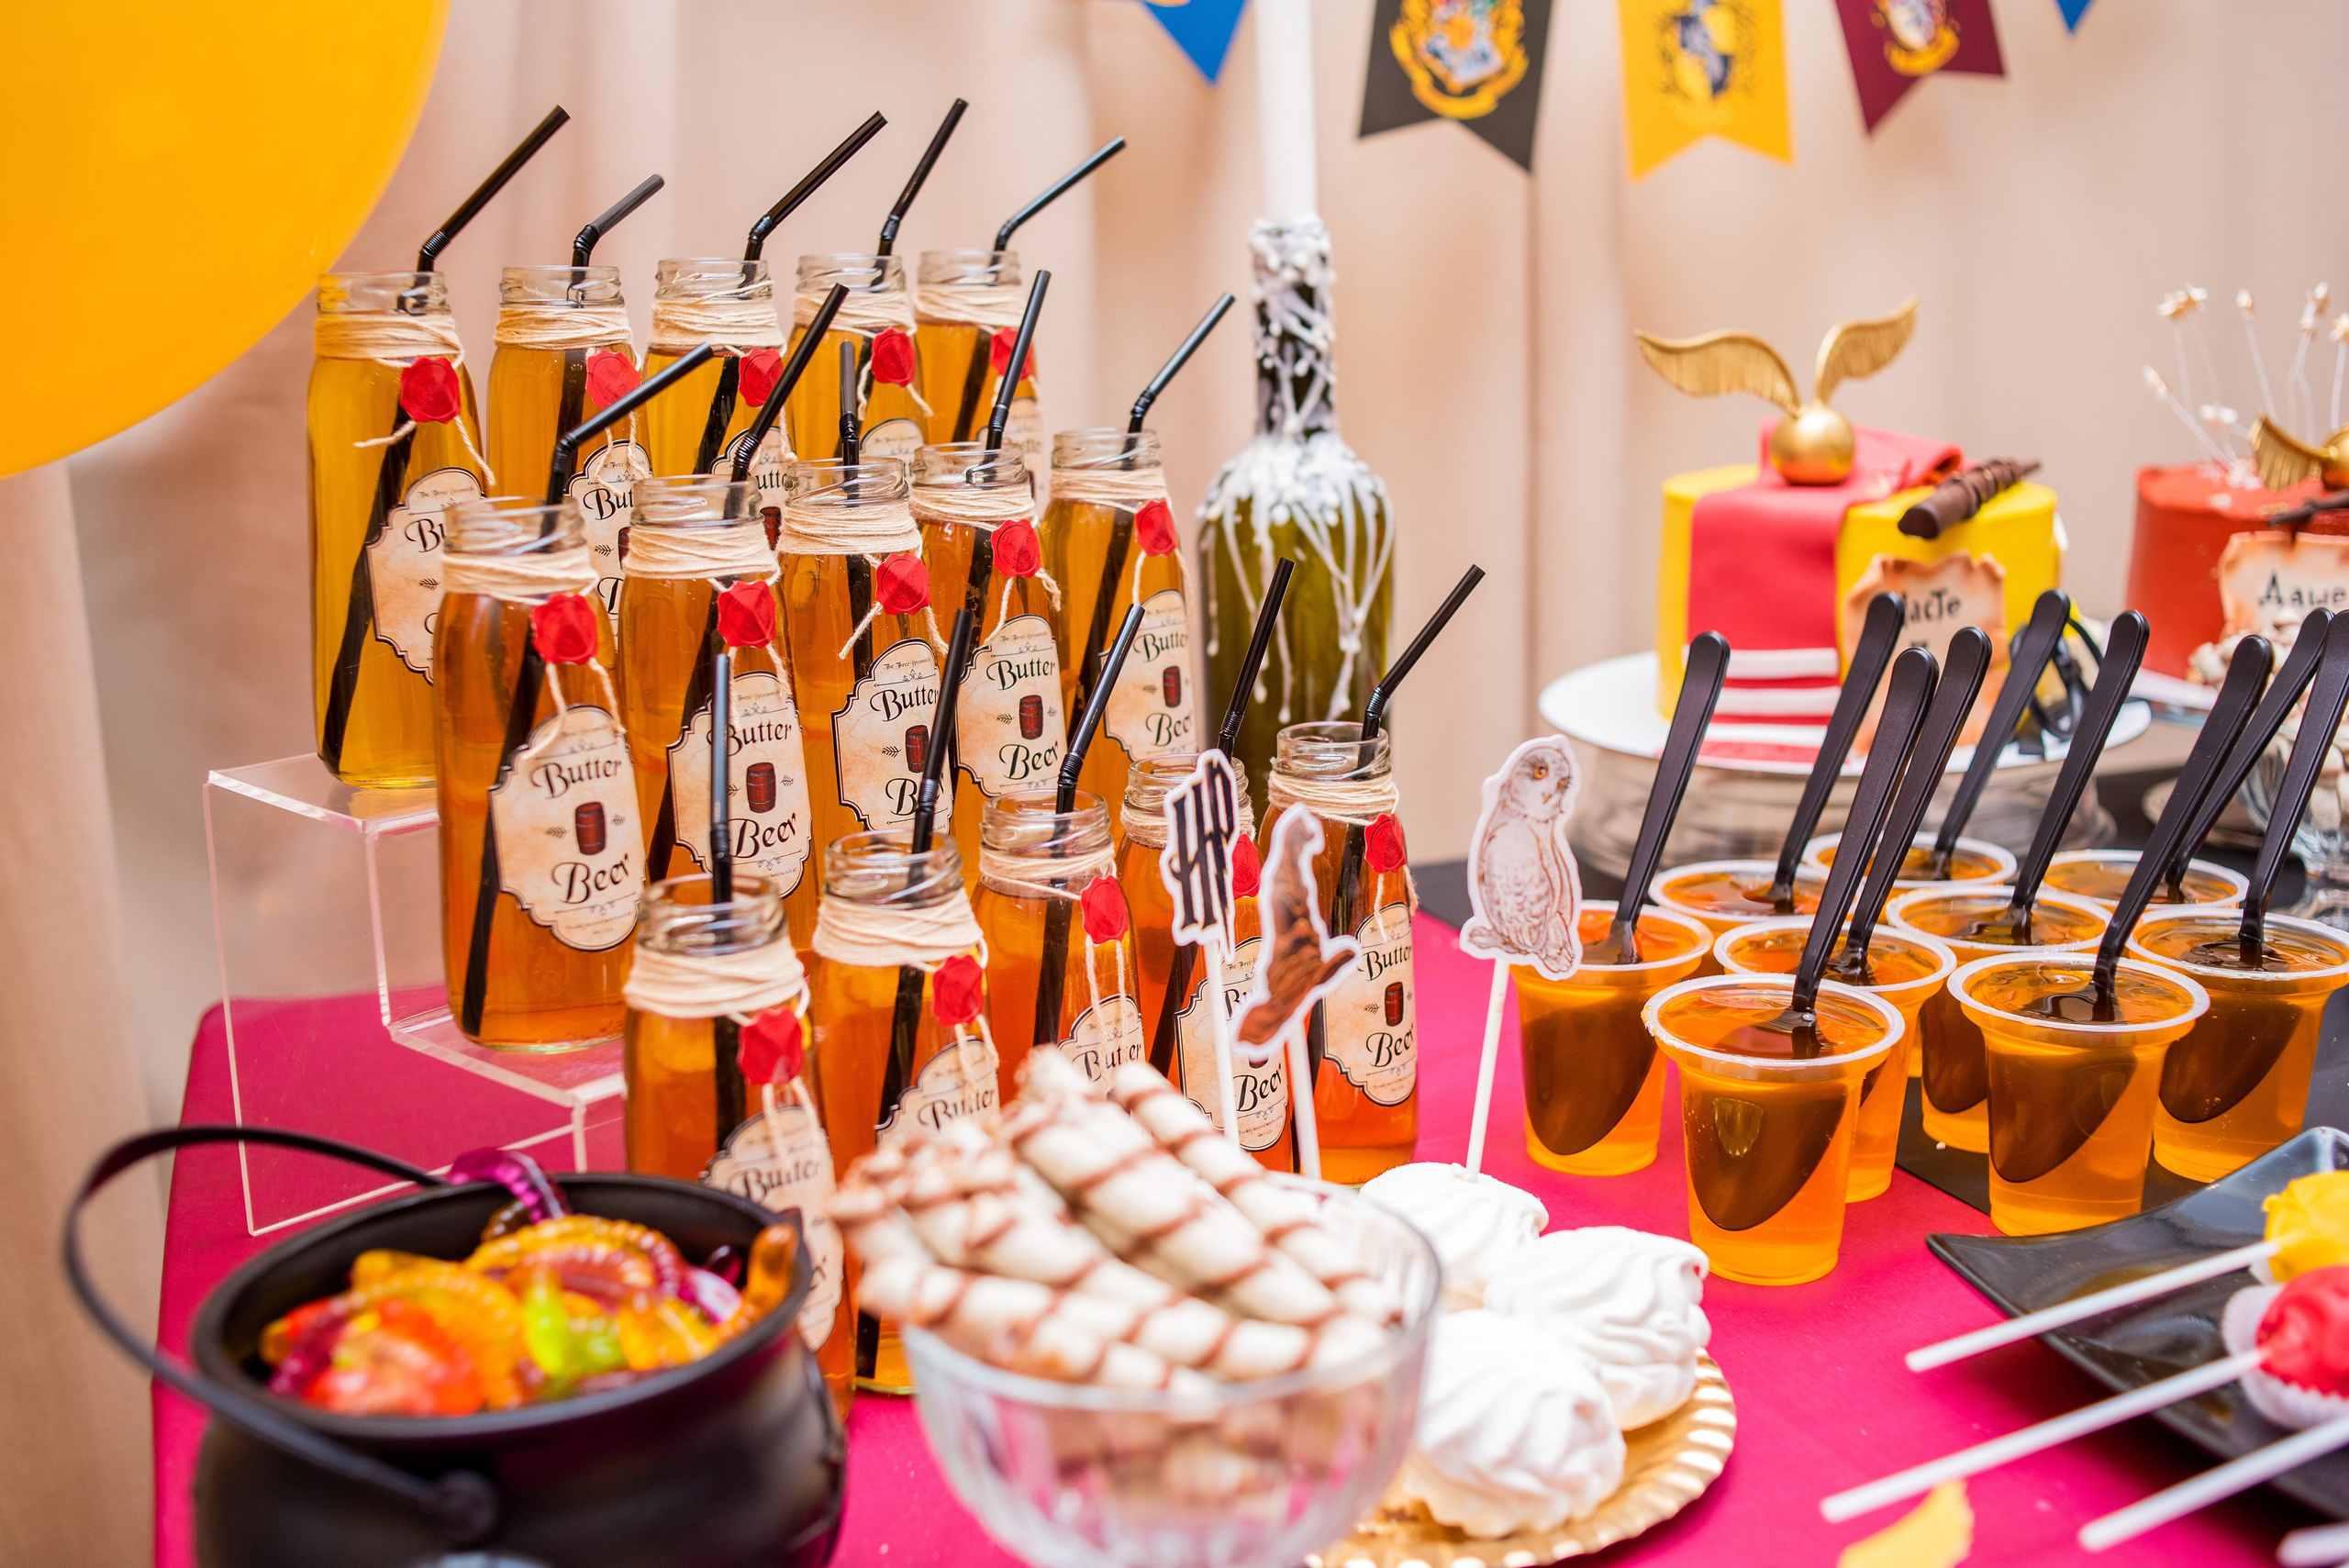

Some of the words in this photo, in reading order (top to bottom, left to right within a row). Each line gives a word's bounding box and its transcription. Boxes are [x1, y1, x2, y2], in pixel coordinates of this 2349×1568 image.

[985, 658, 1056, 691] Butter
[869, 684, 940, 722] Butter
[529, 757, 622, 799] Butter
[998, 740, 1059, 780] Beer
[728, 812, 796, 859] Beer
[551, 852, 629, 905] Beer
[1356, 944, 1412, 982] Butter
[1232, 1062, 1282, 1112] Beer
